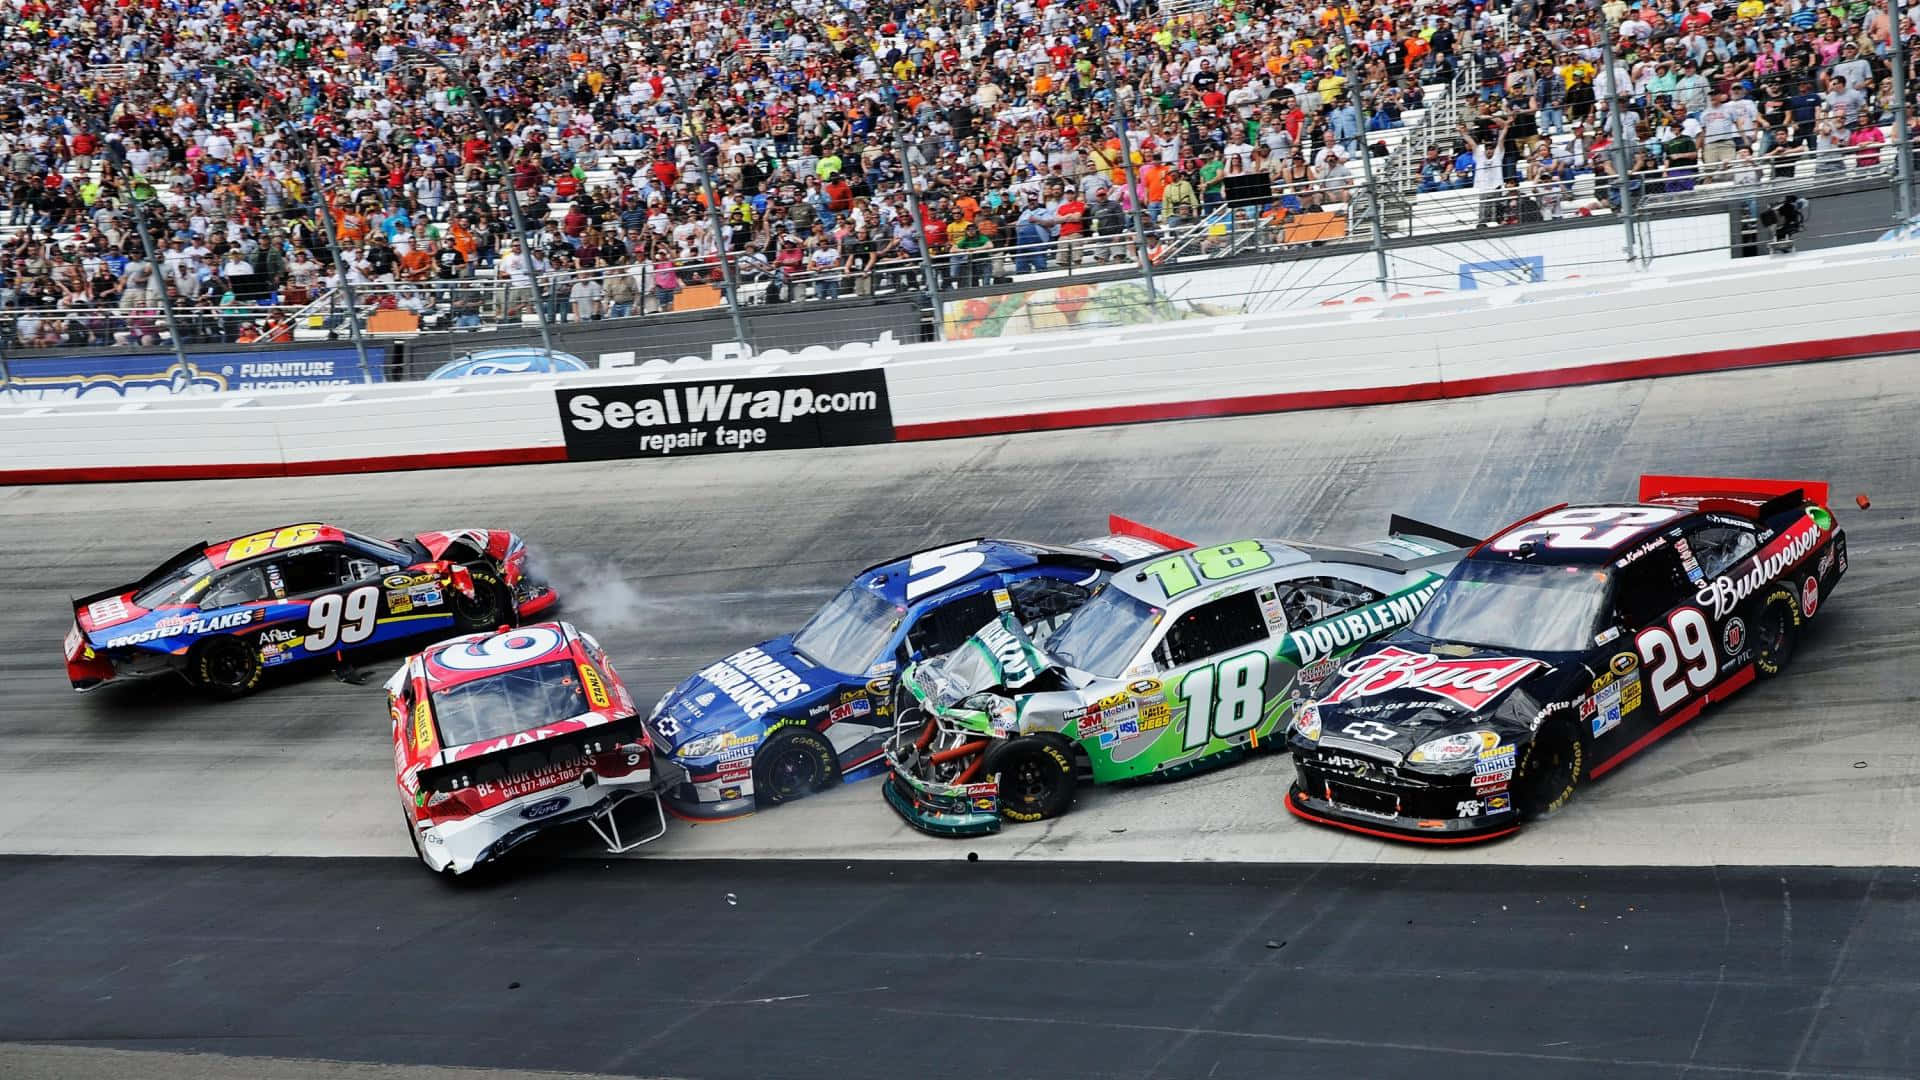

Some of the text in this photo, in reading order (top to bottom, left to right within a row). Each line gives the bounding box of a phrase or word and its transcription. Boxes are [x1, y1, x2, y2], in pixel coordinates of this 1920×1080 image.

[240, 361, 335, 379] FURNITURE
[568, 382, 877, 431] SealWrap.com
[639, 426, 767, 454] repair tape
[1143, 540, 1274, 598] 18
[1696, 524, 1822, 621] Budweiser
[187, 610, 254, 634] FLAKES
[304, 585, 380, 651] 99
[106, 625, 185, 649] FROSTED
[1636, 606, 1718, 713] 29
[584, 666, 605, 703] STANLEY
[724, 647, 811, 703] FARMERS
[1338, 652, 1551, 703] Bud
[1103, 705, 1126, 718] Mobil
[1180, 649, 1269, 750] 18
[1386, 702, 1406, 711] OF
[417, 704, 429, 743] STANLEY
[831, 704, 852, 721] 3M
[1079, 713, 1102, 729] 3M
[1120, 720, 1137, 733] USG
[565, 755, 597, 769] BOSS
[627, 754, 641, 767] 9
[1042, 746, 1070, 773] EAGLE
[1476, 757, 1515, 774] MAHLE
[1473, 773, 1503, 785] COMP
[528, 801, 561, 817] Ford
